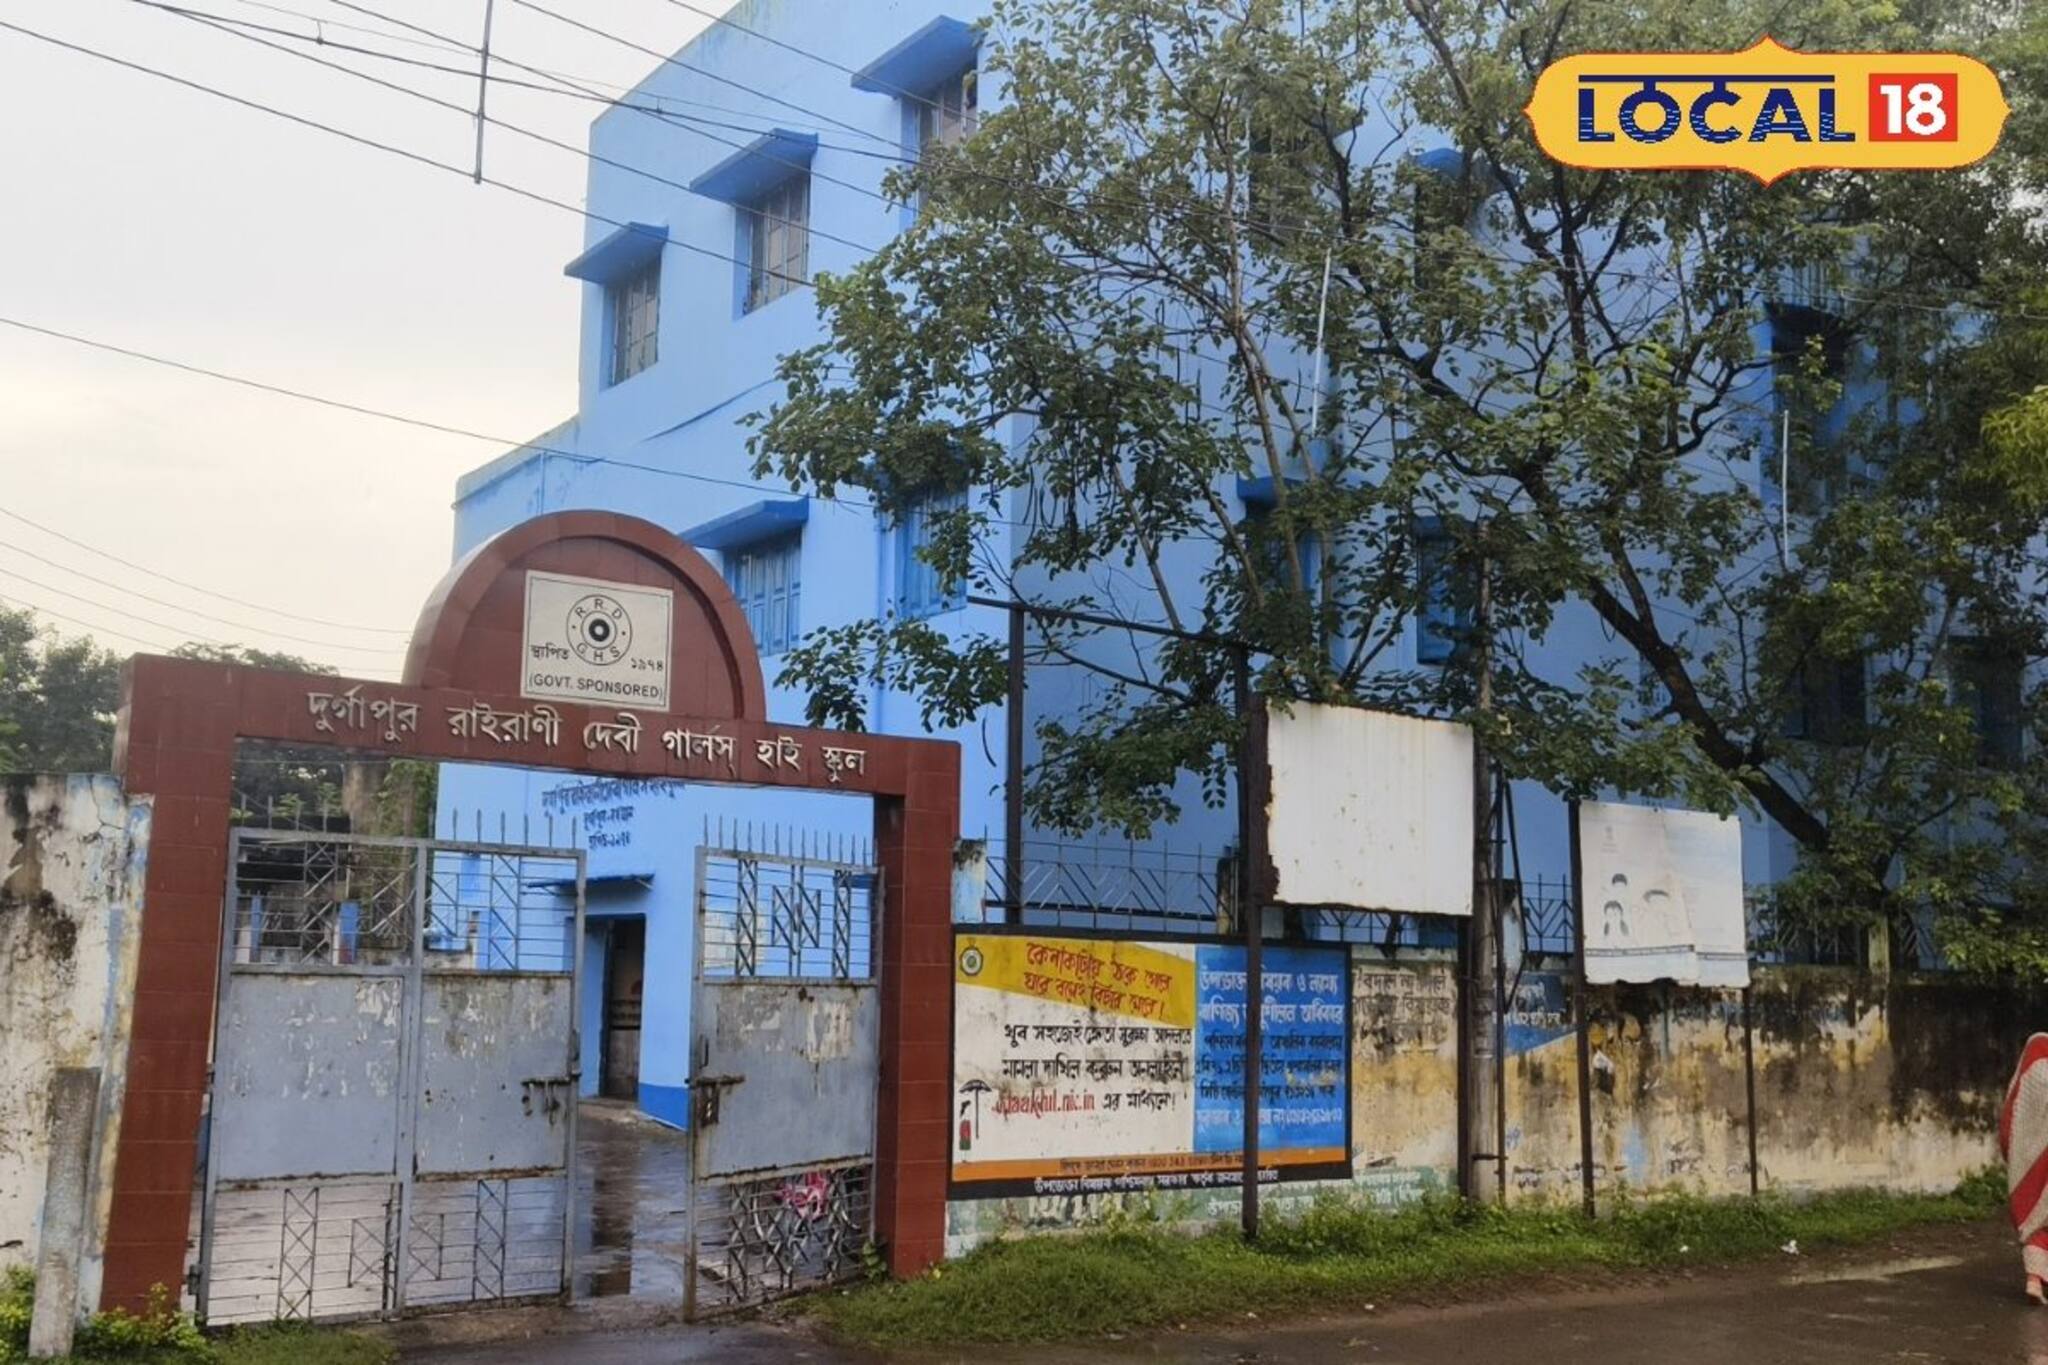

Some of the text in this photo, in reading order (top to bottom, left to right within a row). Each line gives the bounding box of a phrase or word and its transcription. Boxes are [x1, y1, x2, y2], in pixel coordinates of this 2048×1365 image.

[529, 673, 664, 700] (GOVT. SPONSORED)
[306, 684, 421, 743] দুর্গাপুর
[447, 701, 563, 746] রাইরাণী
[583, 712, 642, 753] দেবী
[755, 736, 802, 770] হাই
[822, 744, 866, 783] স্কুল
[1004, 1024, 1029, 1048] খুব
[1002, 1059, 1039, 1080] মামলা
[1041, 1052, 1081, 1080] দাখিল
[1103, 1093, 1121, 1112] এর
